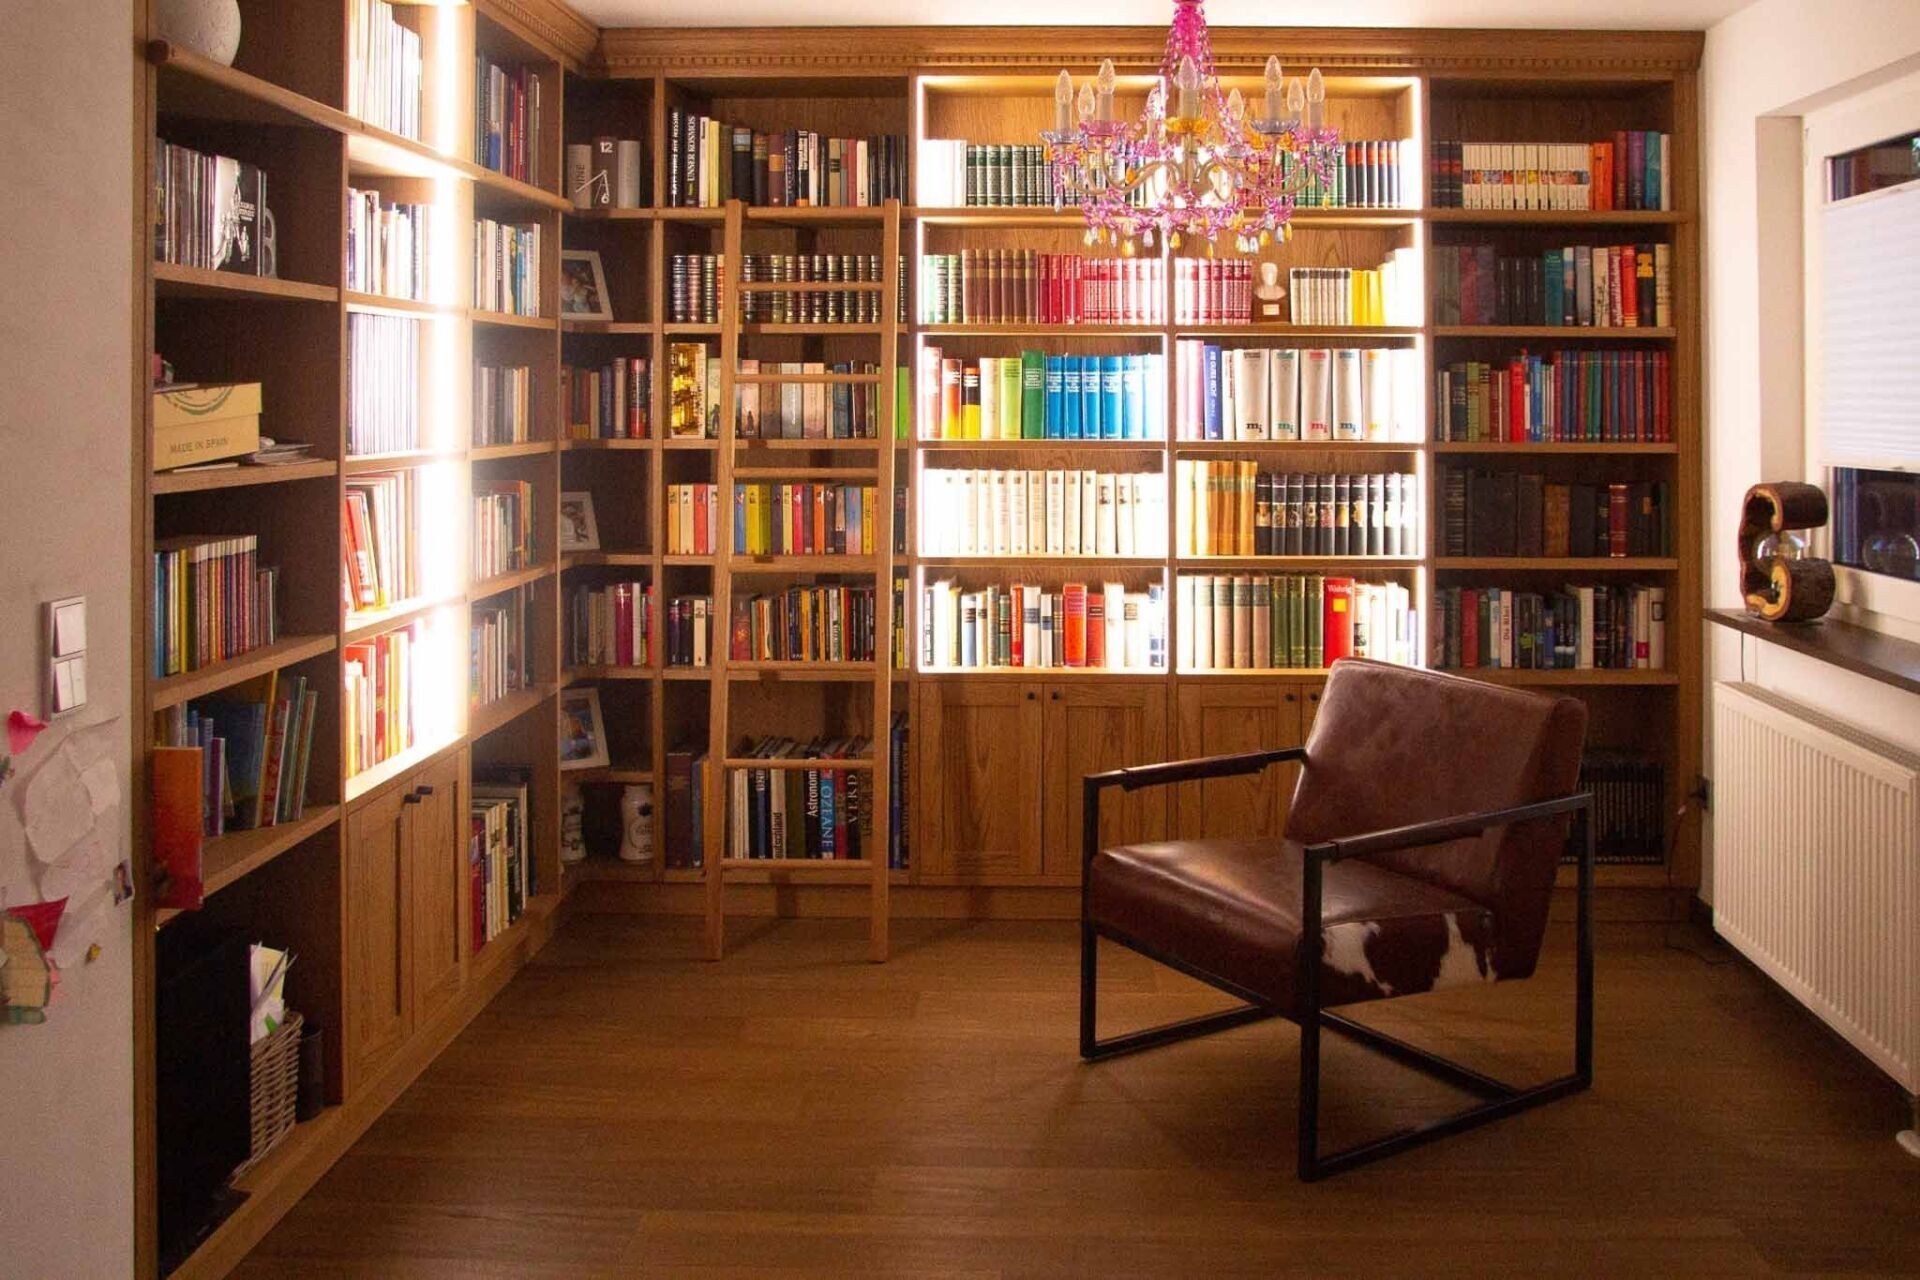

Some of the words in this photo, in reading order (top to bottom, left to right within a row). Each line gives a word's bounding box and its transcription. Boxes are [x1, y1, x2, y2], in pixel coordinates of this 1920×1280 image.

[600, 142, 613, 153] 12
[687, 114, 696, 152] KOSMOS
[687, 153, 696, 182] UNSER
[601, 193, 609, 204] 6
[170, 441, 193, 453] MADE
[195, 440, 204, 449] IN
[206, 437, 229, 449] SPAIN
[848, 770, 858, 823] VERD
[820, 785, 834, 847] OZEANE
